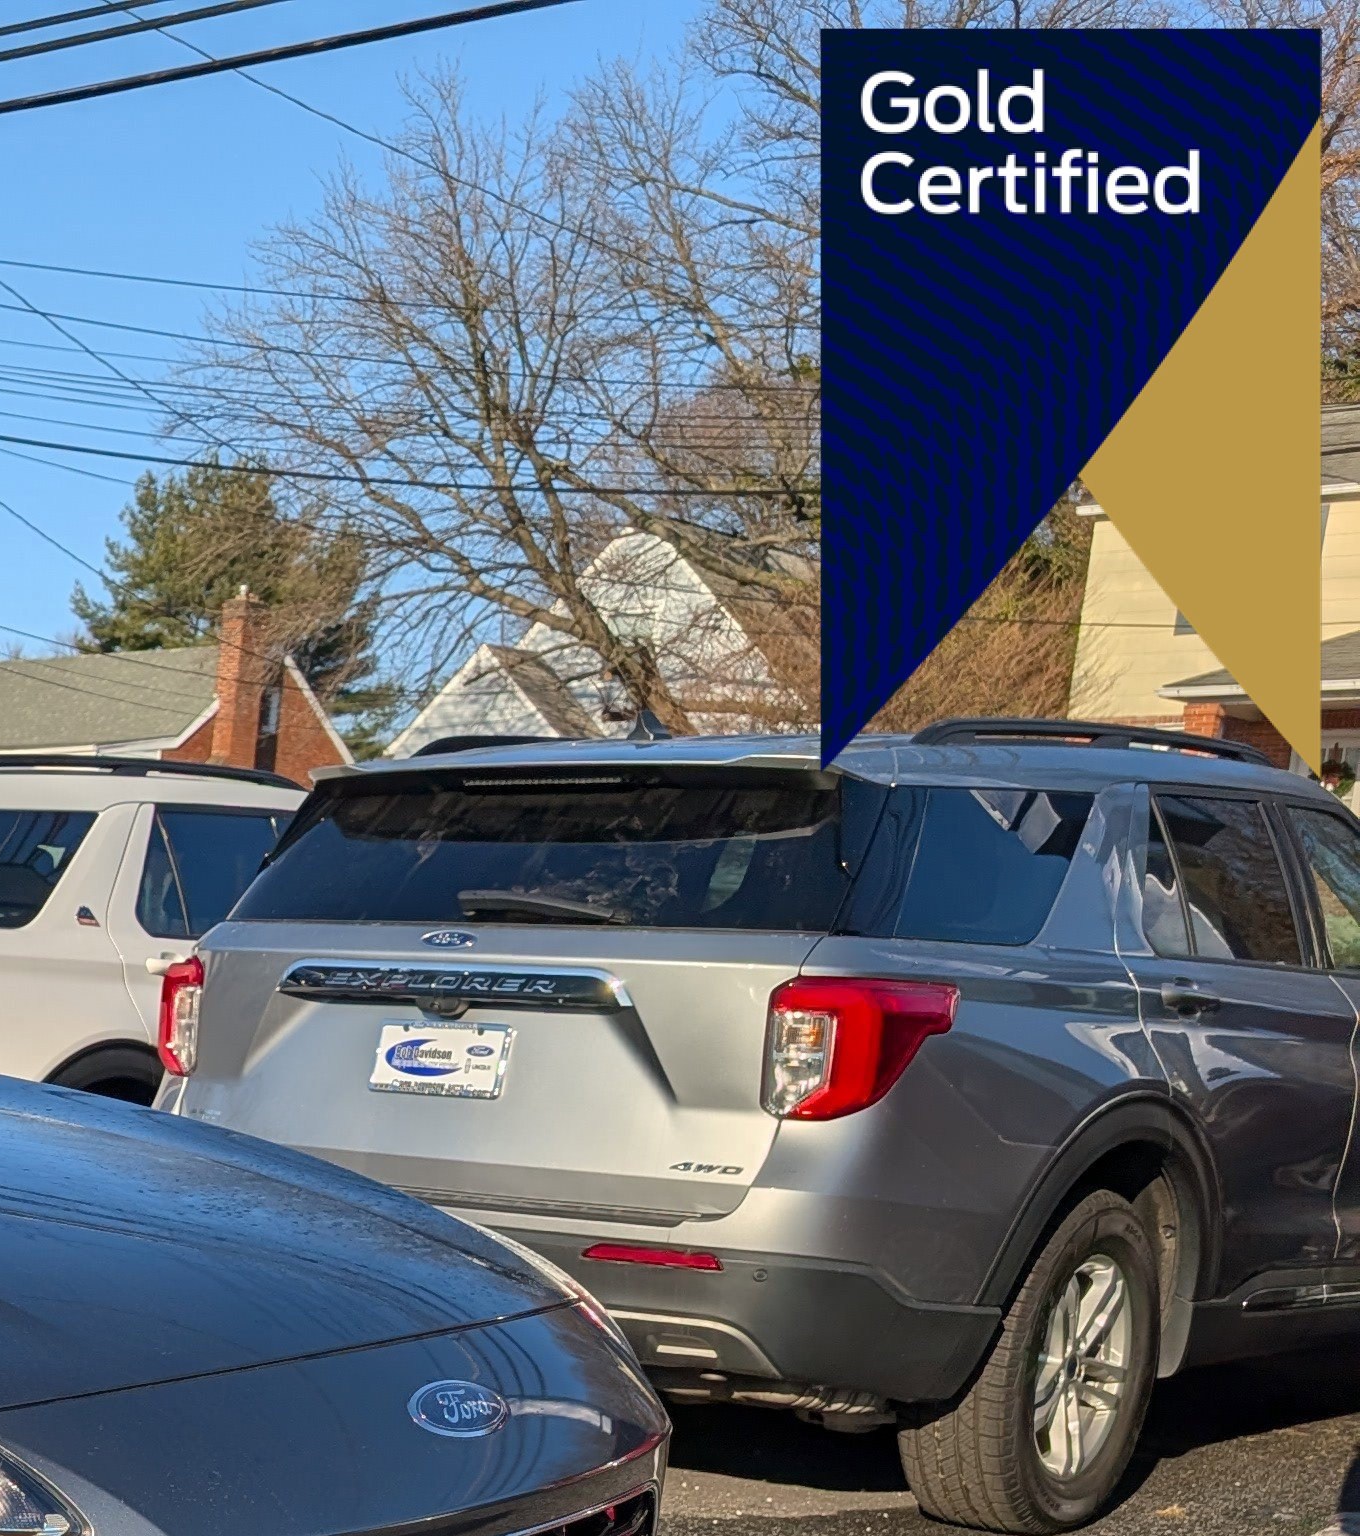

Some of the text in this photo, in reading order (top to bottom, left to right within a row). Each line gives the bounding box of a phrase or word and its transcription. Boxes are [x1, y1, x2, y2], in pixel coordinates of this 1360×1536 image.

[325, 971, 557, 994] EXPLORER
[414, 1045, 453, 1060] Davidson
[668, 1161, 744, 1175] 4WD
[435, 1388, 501, 1424] Ford
